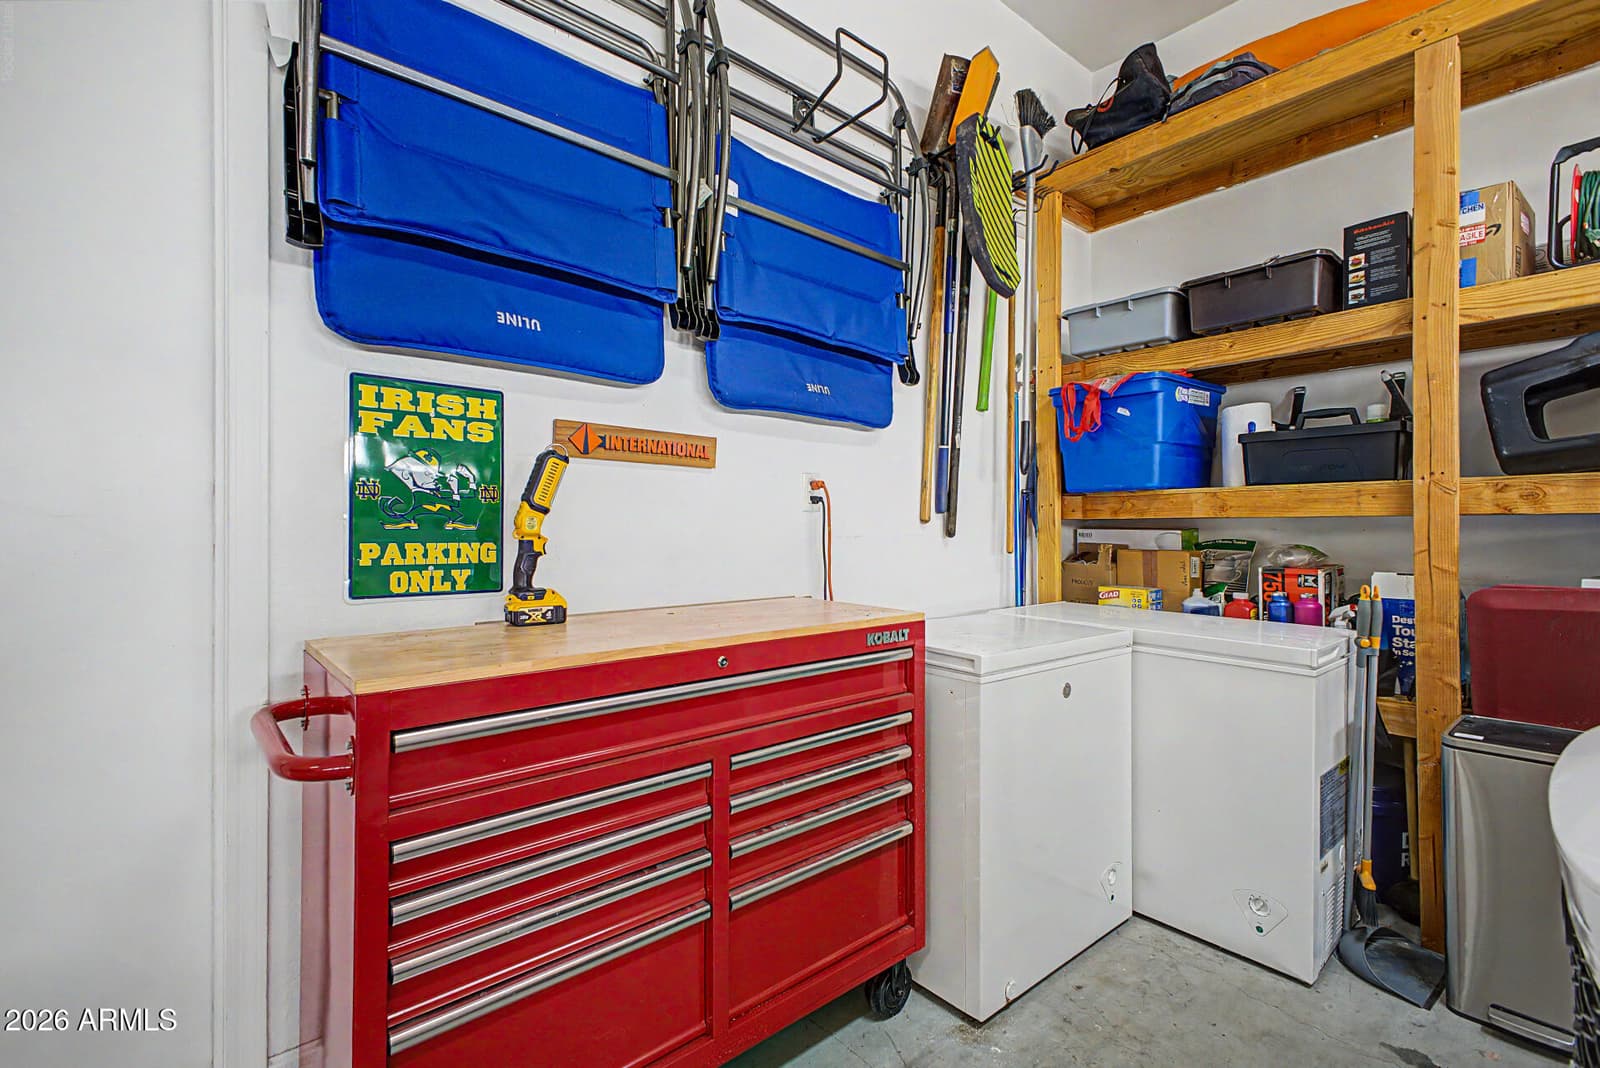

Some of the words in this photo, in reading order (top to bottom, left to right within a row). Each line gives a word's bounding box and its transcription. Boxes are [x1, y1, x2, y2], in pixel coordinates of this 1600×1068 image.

[1459, 203, 1484, 215] CHEN
[496, 311, 541, 331] ULINE
[358, 383, 497, 420] IRISH
[358, 410, 495, 443] FANS
[604, 434, 710, 460] INTERNATIONAL
[359, 542, 497, 567] PARKING
[389, 569, 472, 594] ONLY
[1099, 591, 1119, 599] GLAD
[867, 628, 909, 646] KOBALT
